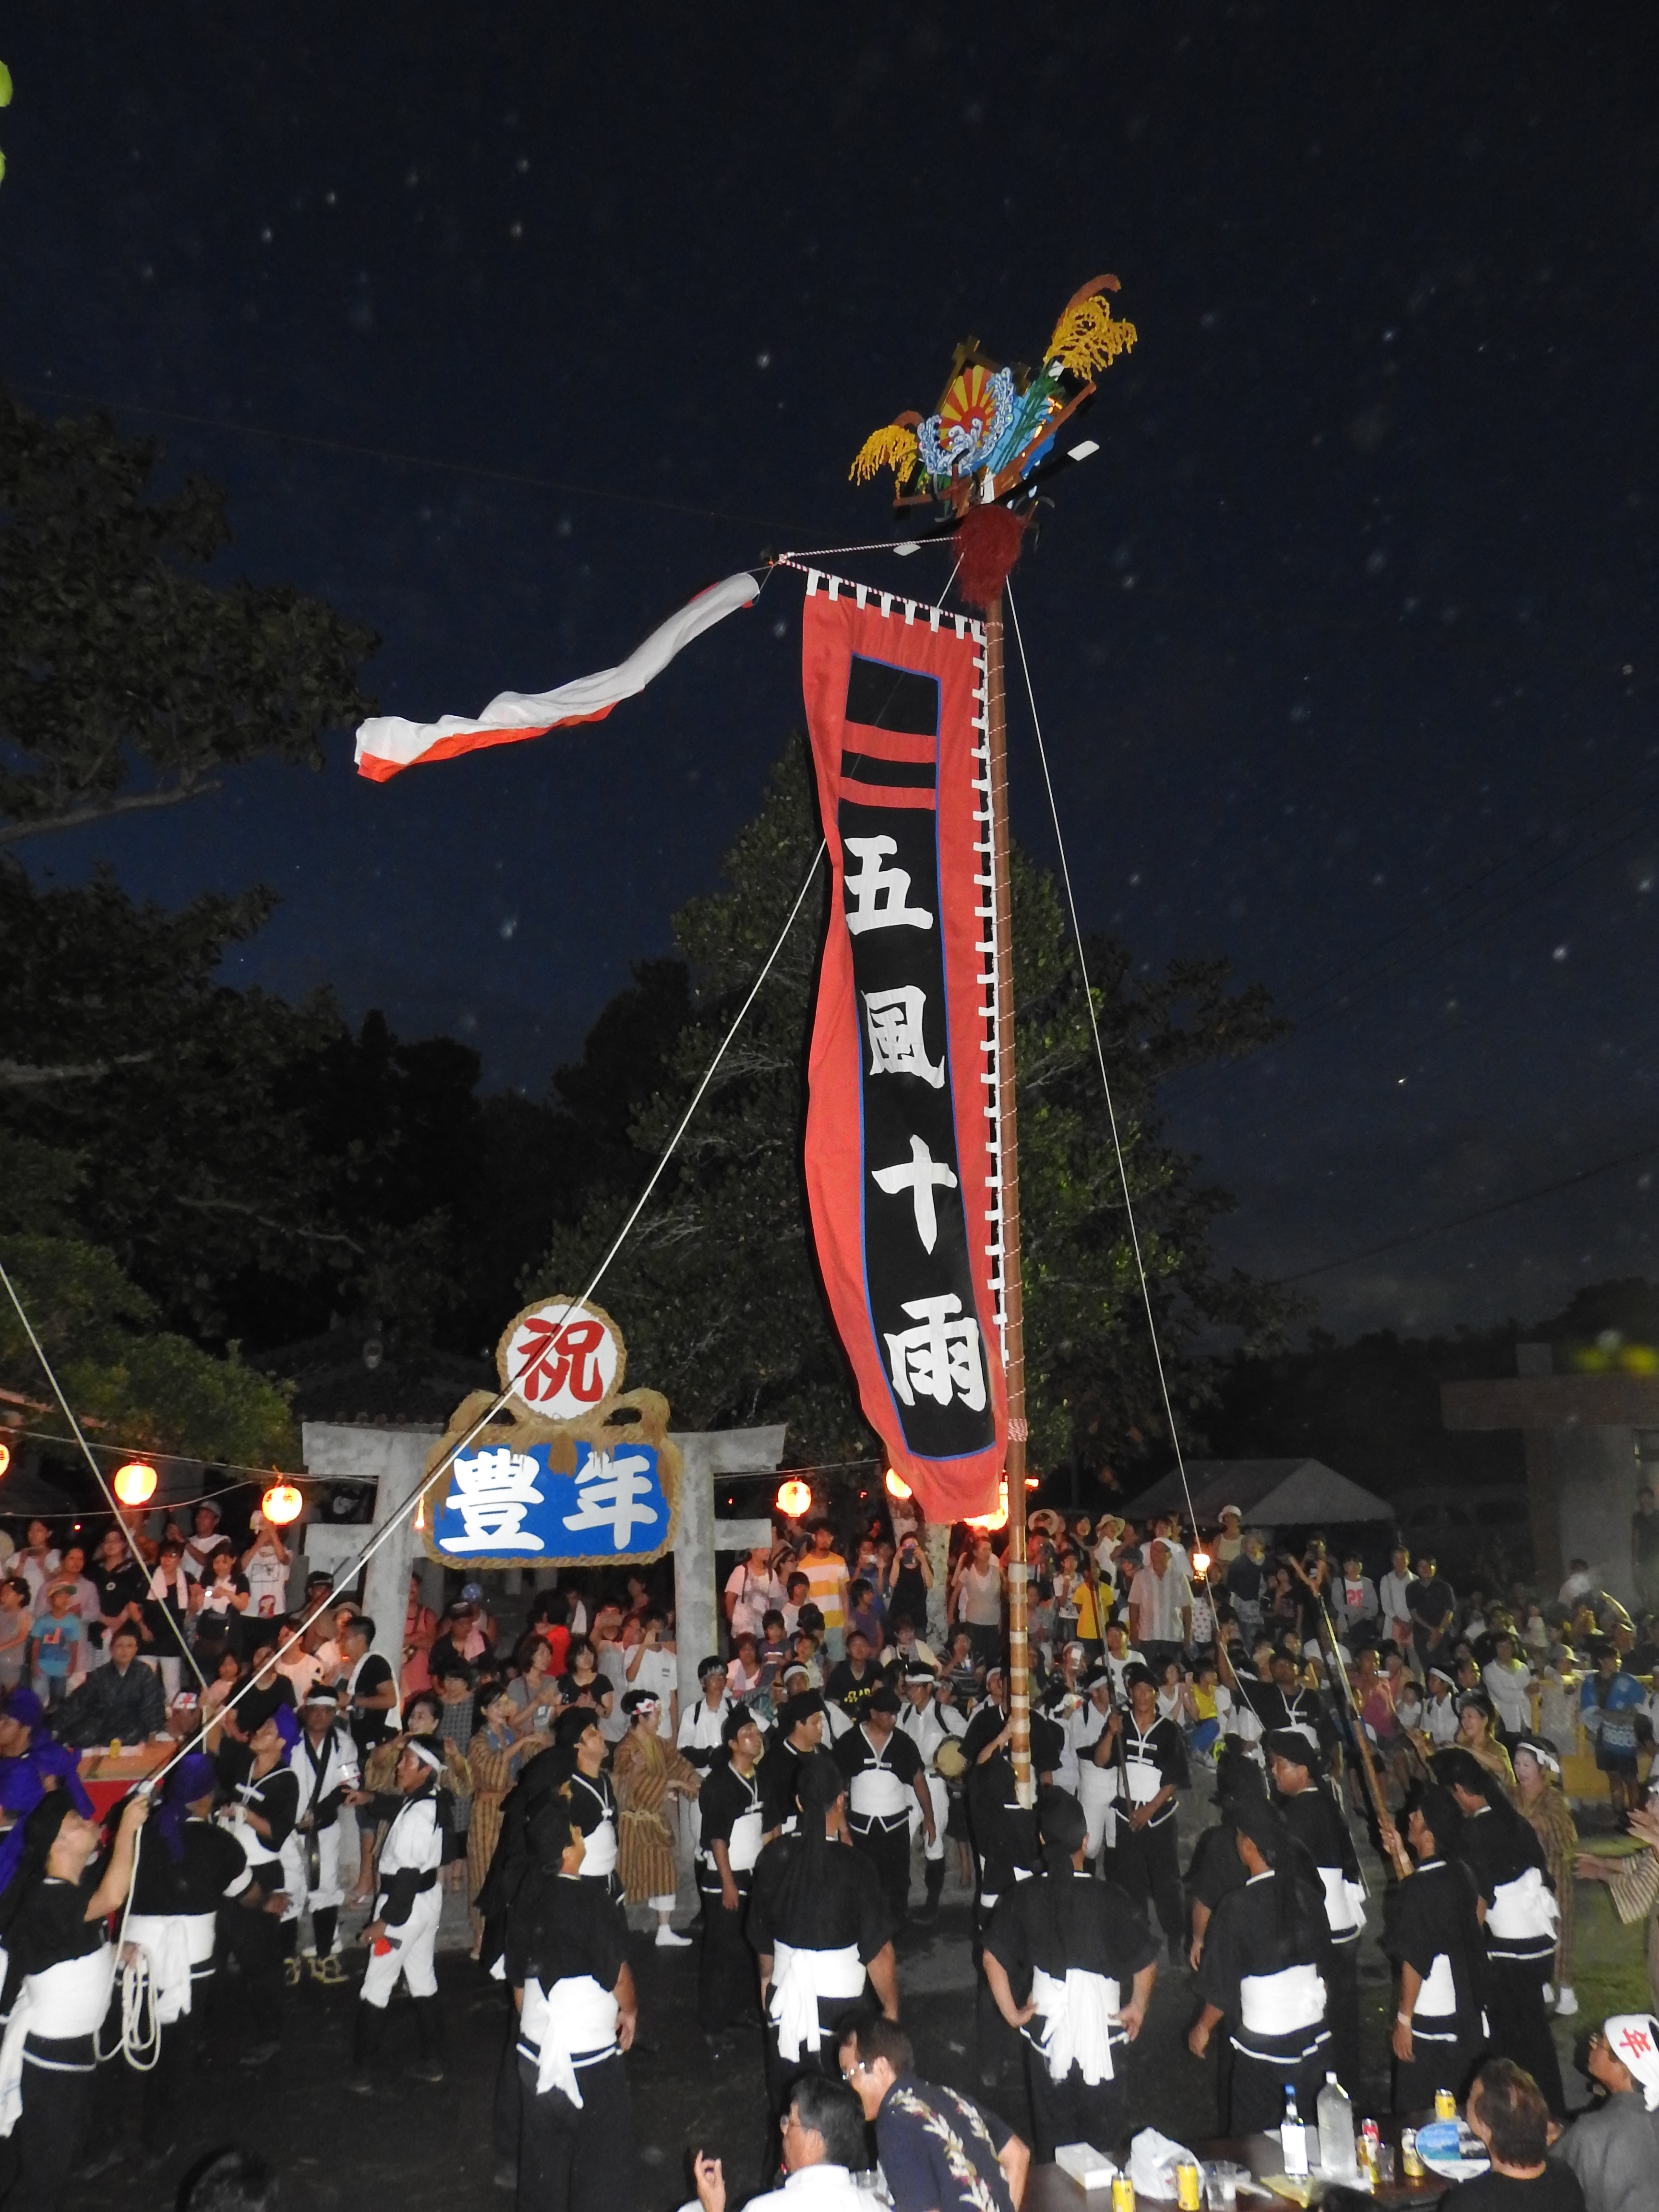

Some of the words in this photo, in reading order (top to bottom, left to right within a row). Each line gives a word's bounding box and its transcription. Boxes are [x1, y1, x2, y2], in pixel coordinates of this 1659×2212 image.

[844, 835, 986, 1411] 五風十雨
[518, 1319, 604, 1402] 祝
[440, 1448, 657, 1552] 豊年
